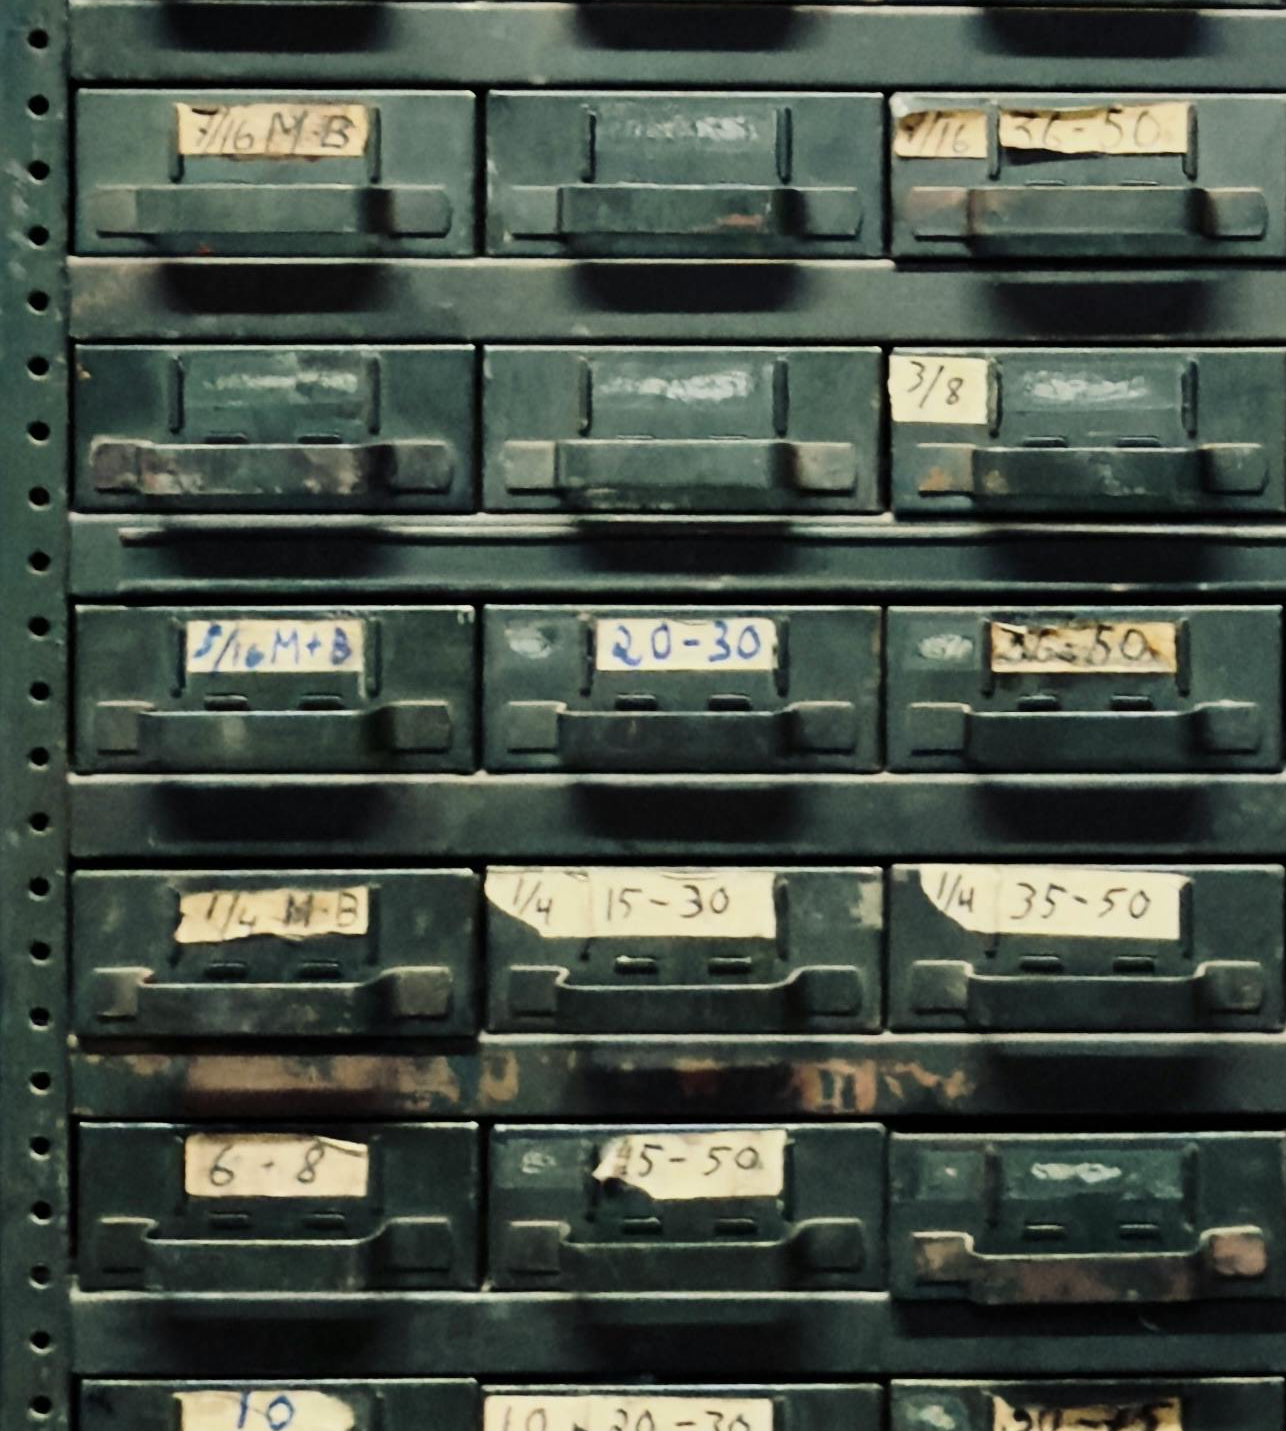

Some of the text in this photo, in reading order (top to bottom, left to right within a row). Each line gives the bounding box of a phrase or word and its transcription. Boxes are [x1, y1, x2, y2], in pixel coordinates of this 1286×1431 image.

[908, 361, 963, 407] 3/8
[511, 878, 554, 924] 1/4
[937, 873, 975, 915] 1/4
[237, 1392, 296, 1431] 10
